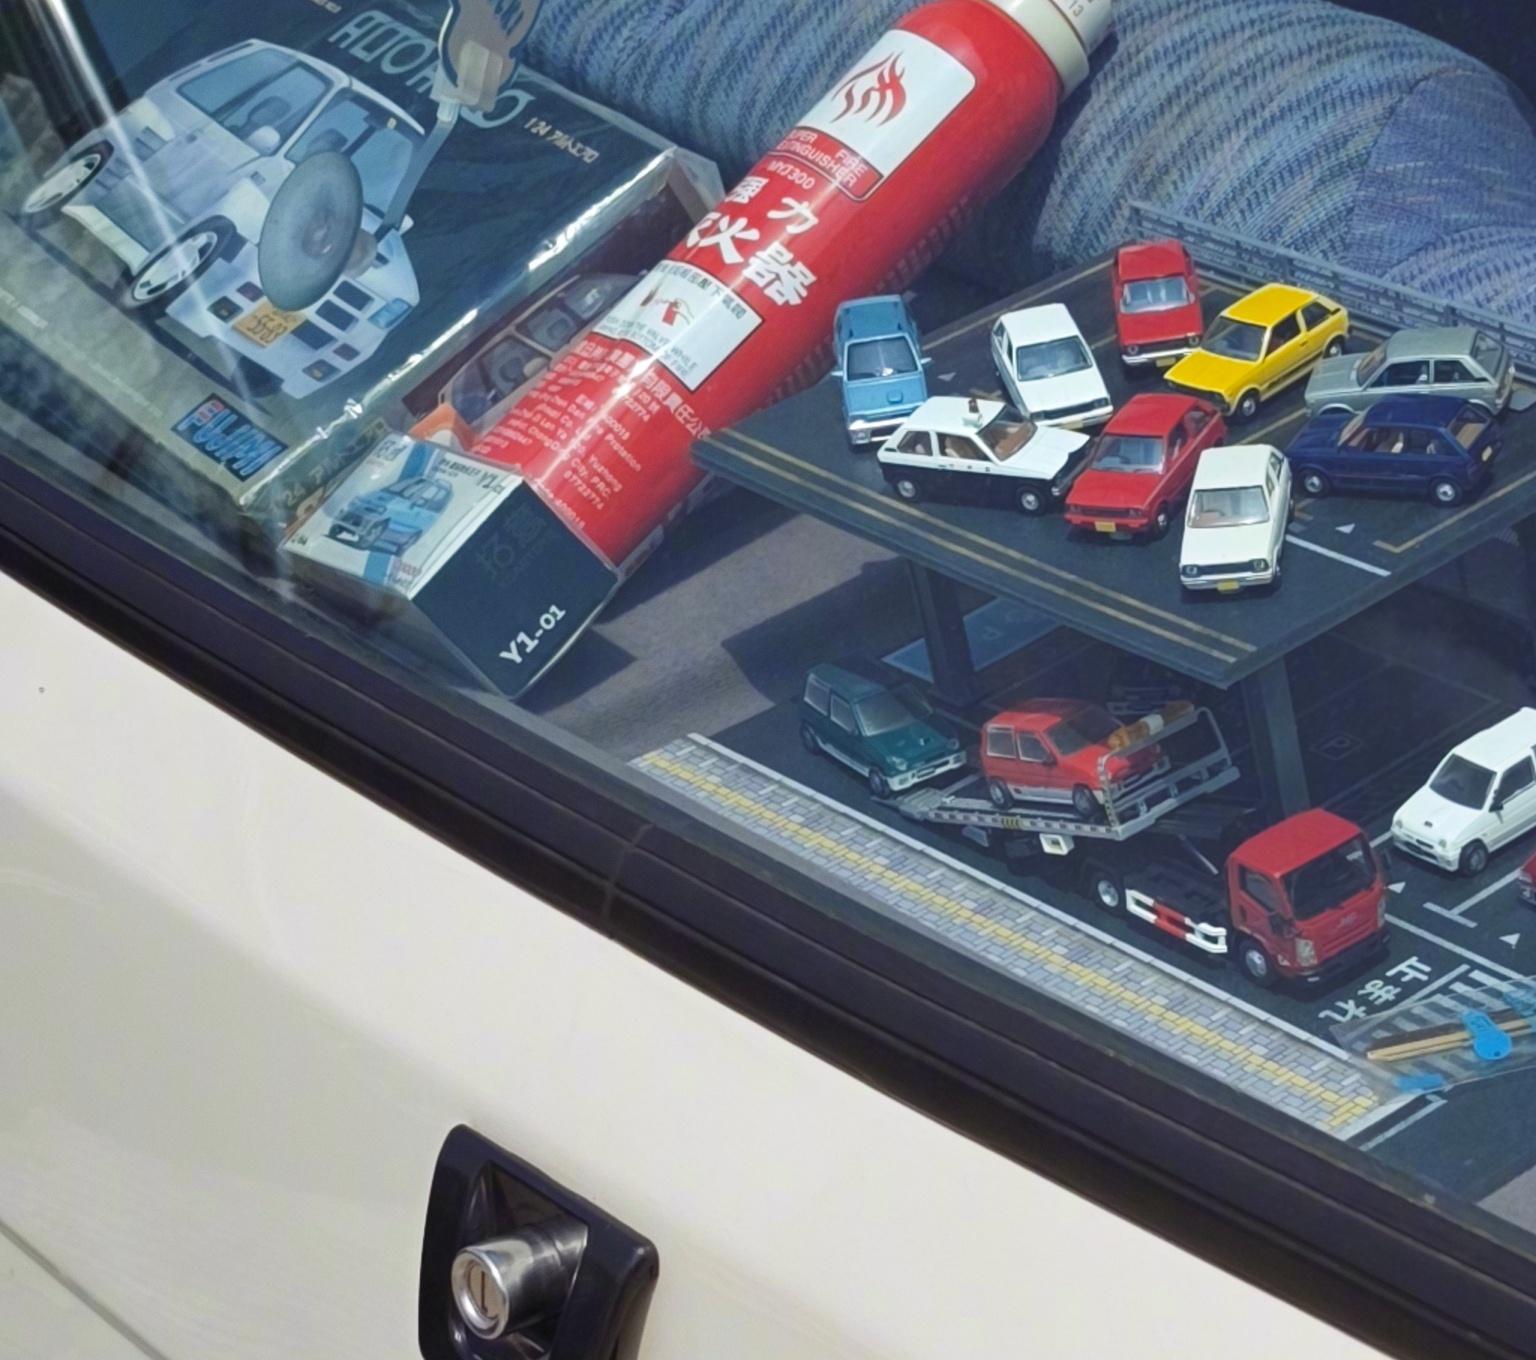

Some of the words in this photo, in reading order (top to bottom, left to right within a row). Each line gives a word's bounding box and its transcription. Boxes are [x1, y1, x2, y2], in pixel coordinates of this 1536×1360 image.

[834, 149, 868, 178] FIRE
[176, 398, 283, 477] FUJIMI
[500, 603, 567, 668] Y1-01
[1318, 955, 1432, 1024] 止まれ
